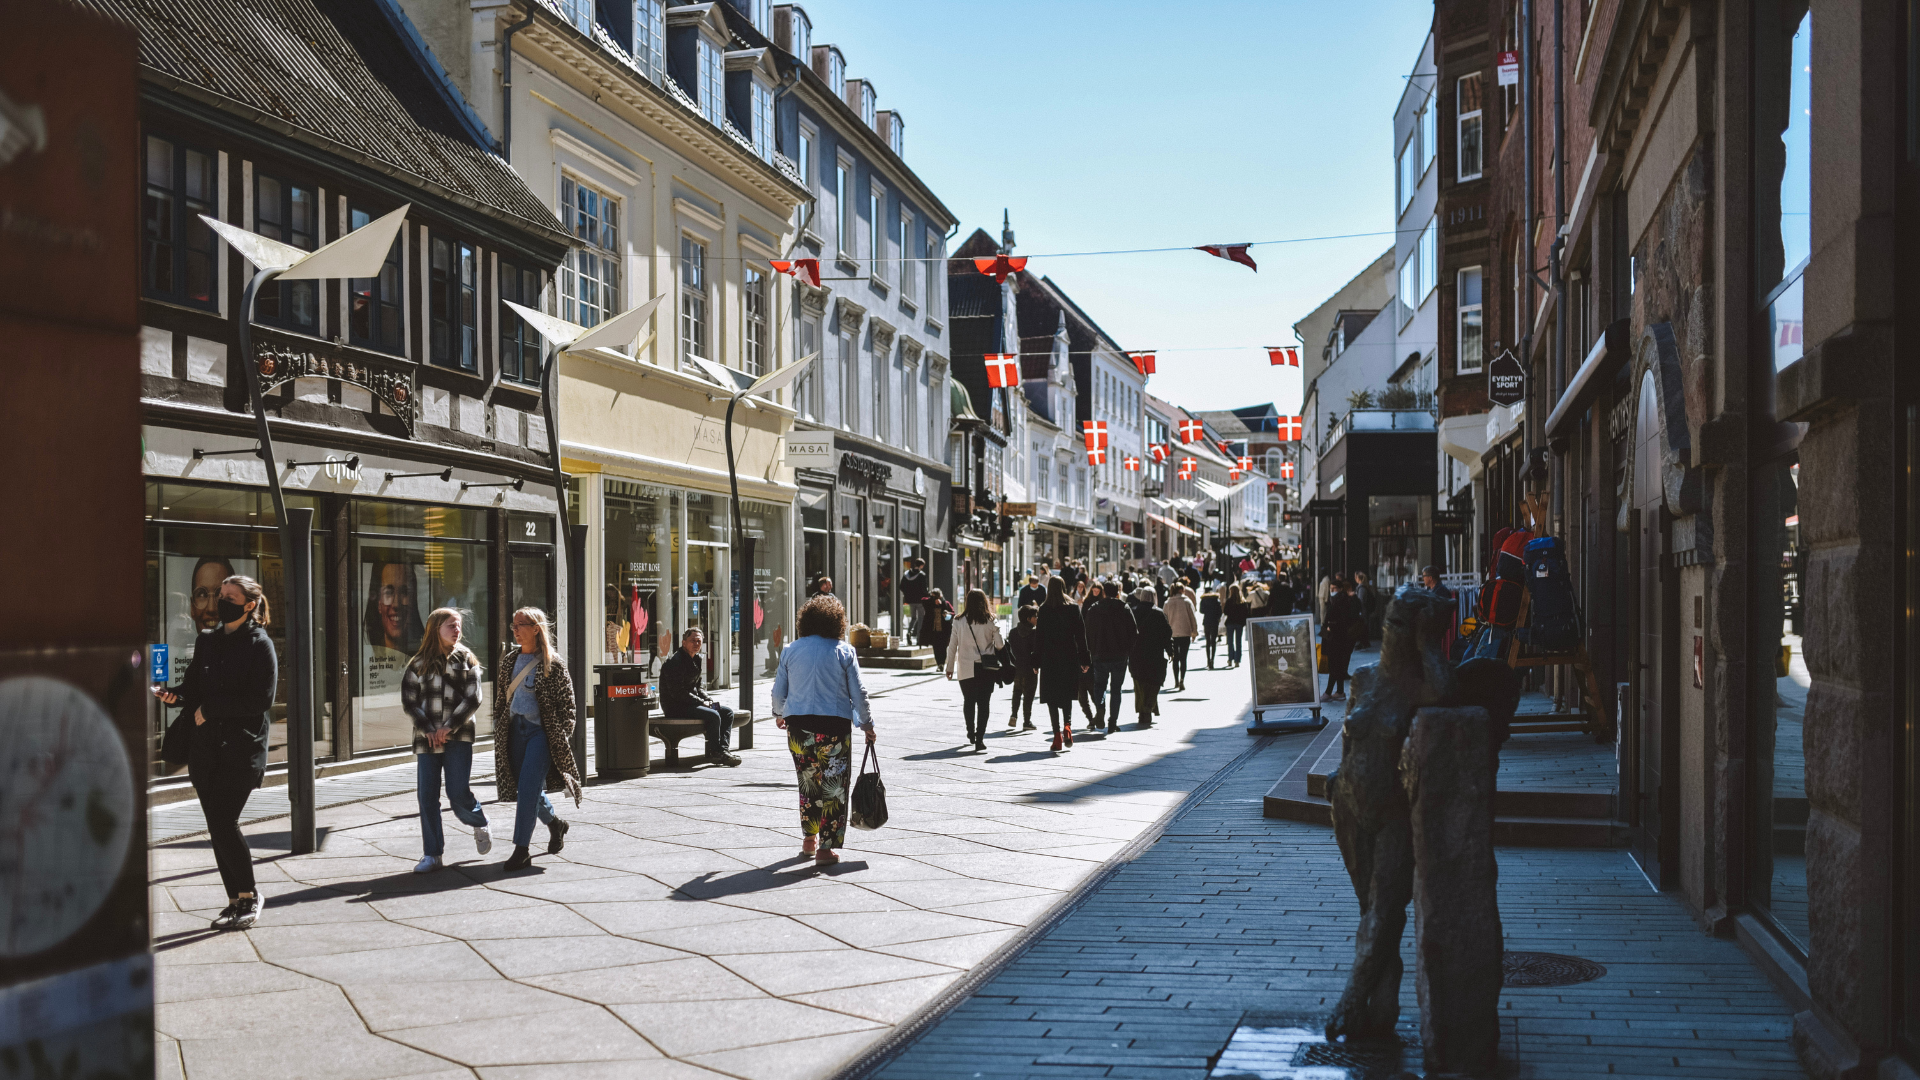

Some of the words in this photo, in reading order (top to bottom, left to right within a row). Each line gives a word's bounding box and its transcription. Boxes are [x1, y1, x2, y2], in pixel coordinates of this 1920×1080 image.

[1450, 204, 1482, 225] 1911
[1491, 375, 1523, 383] EVENTYR
[693, 424, 723, 446] MASA
[525, 521, 536, 536] 22
[629, 562, 647, 572] DESERT
[1267, 633, 1296, 646] Run
[615, 686, 637, 695] Metal
